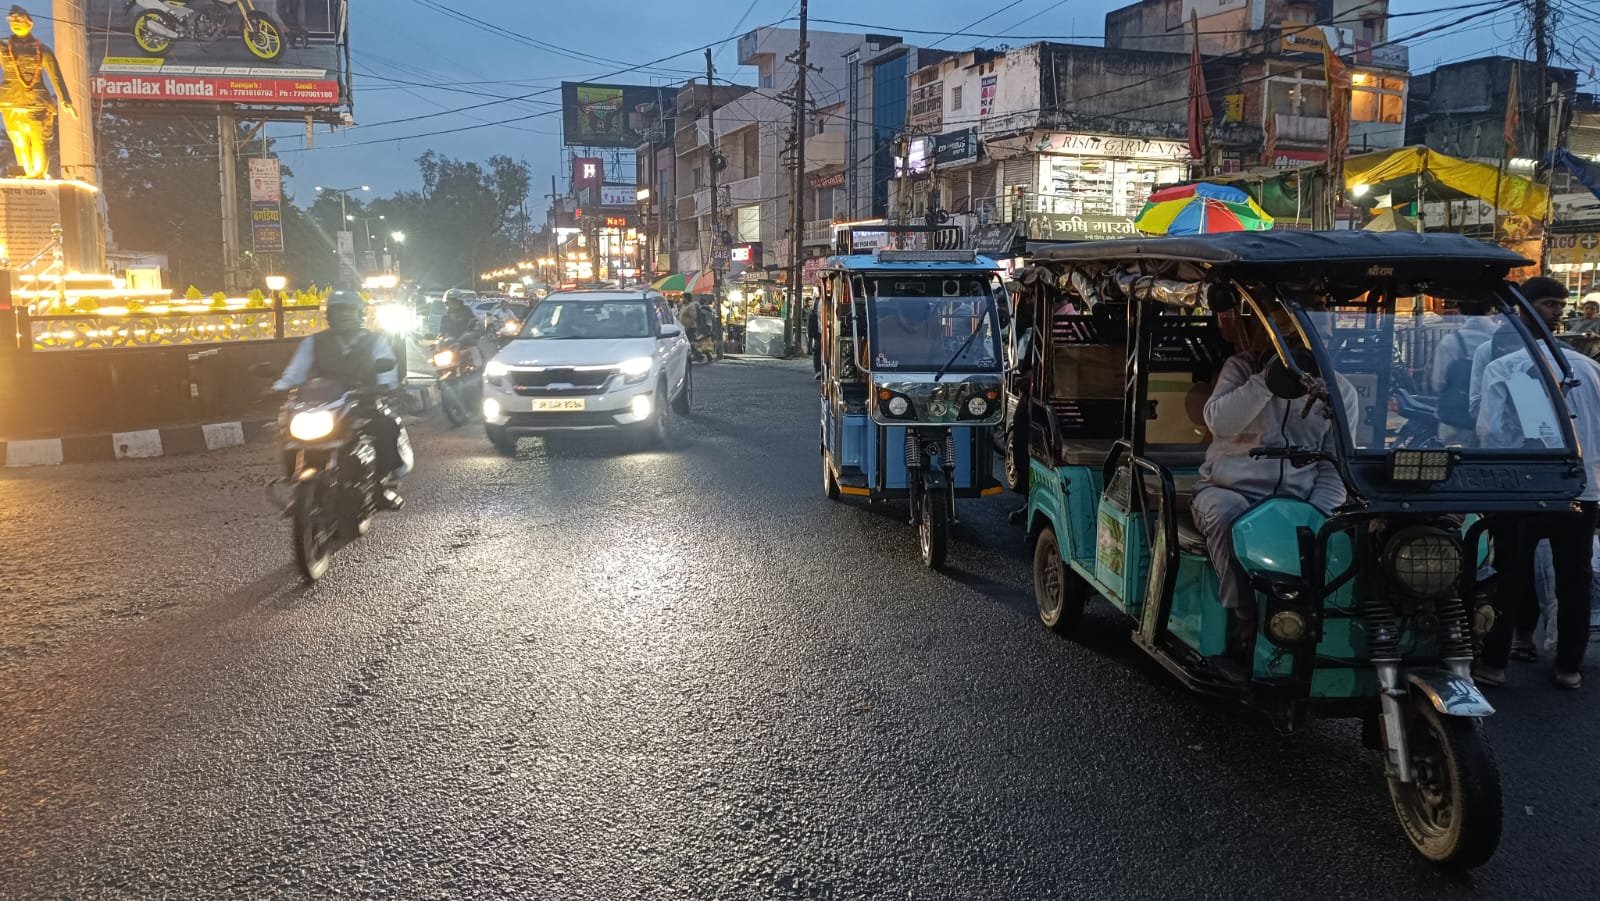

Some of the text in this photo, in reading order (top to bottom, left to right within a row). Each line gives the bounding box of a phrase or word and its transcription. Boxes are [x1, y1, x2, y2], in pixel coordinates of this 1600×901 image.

[97, 78, 213, 96] Parallax Honda
[1092, 218, 1140, 234] गारमे
